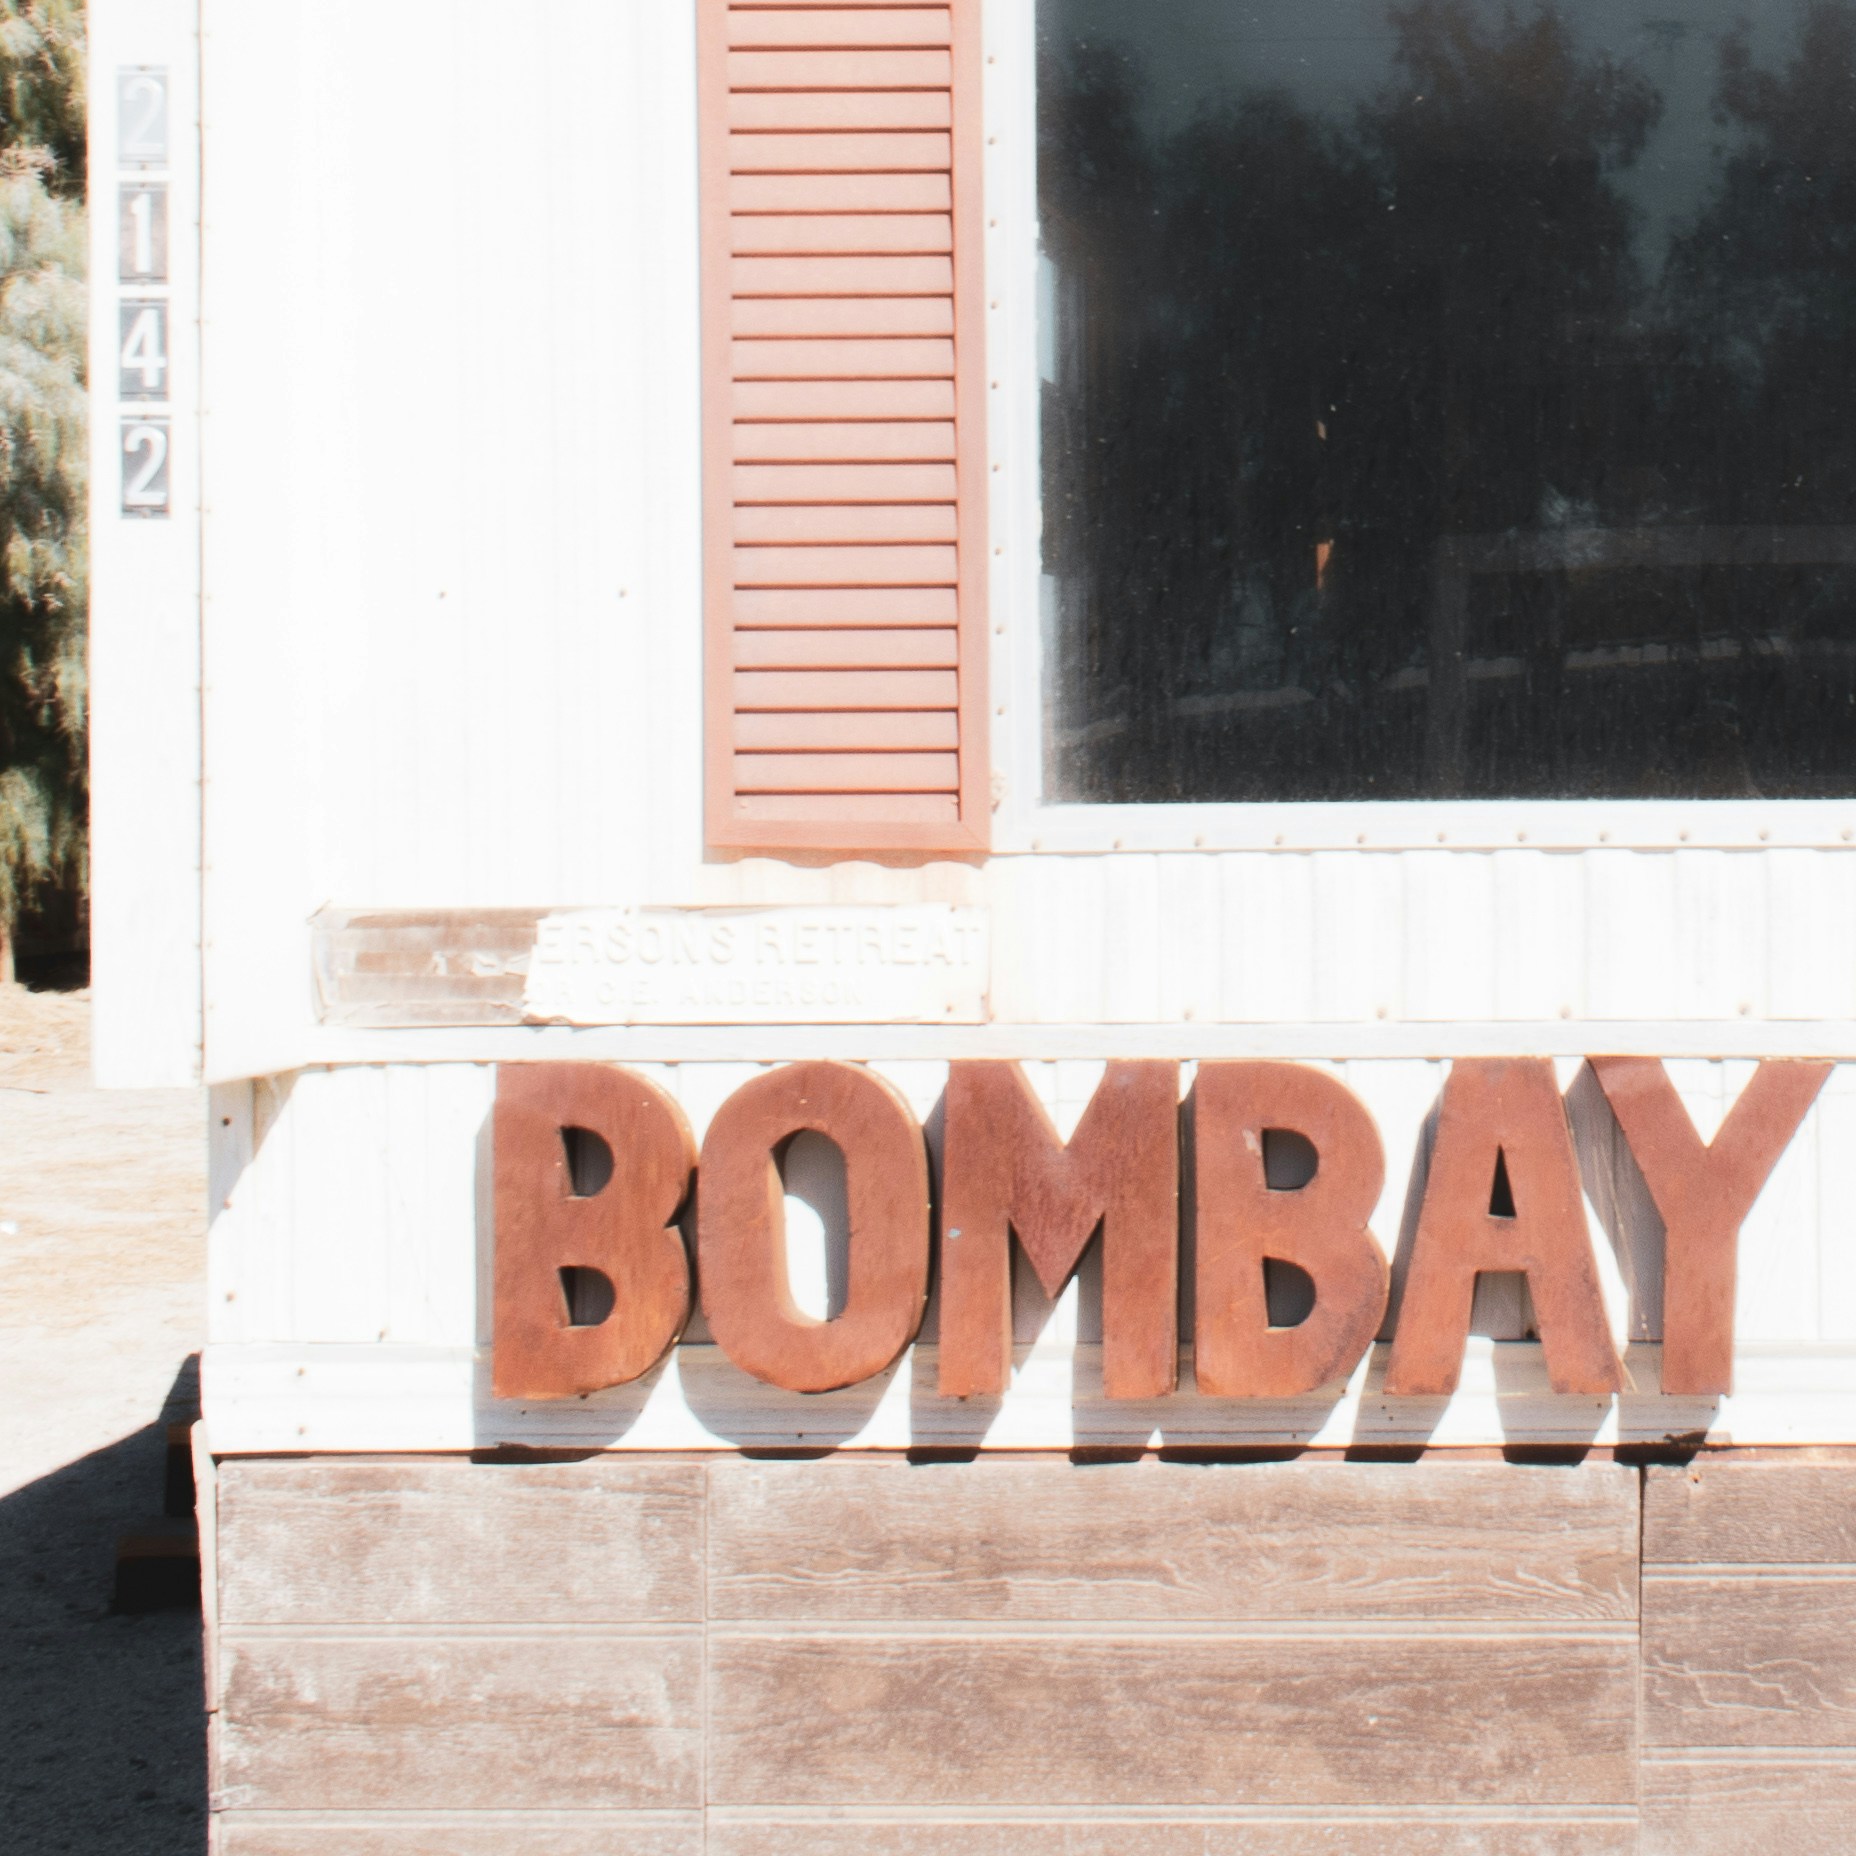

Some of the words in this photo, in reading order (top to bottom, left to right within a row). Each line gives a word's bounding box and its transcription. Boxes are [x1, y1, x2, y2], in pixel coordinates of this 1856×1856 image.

[121, 77, 168, 506] 2142
[678, 978, 864, 1007] ANDERSON
[754, 920, 982, 968] RETREAT
[491, 1058, 1834, 1400] BOMBAY
